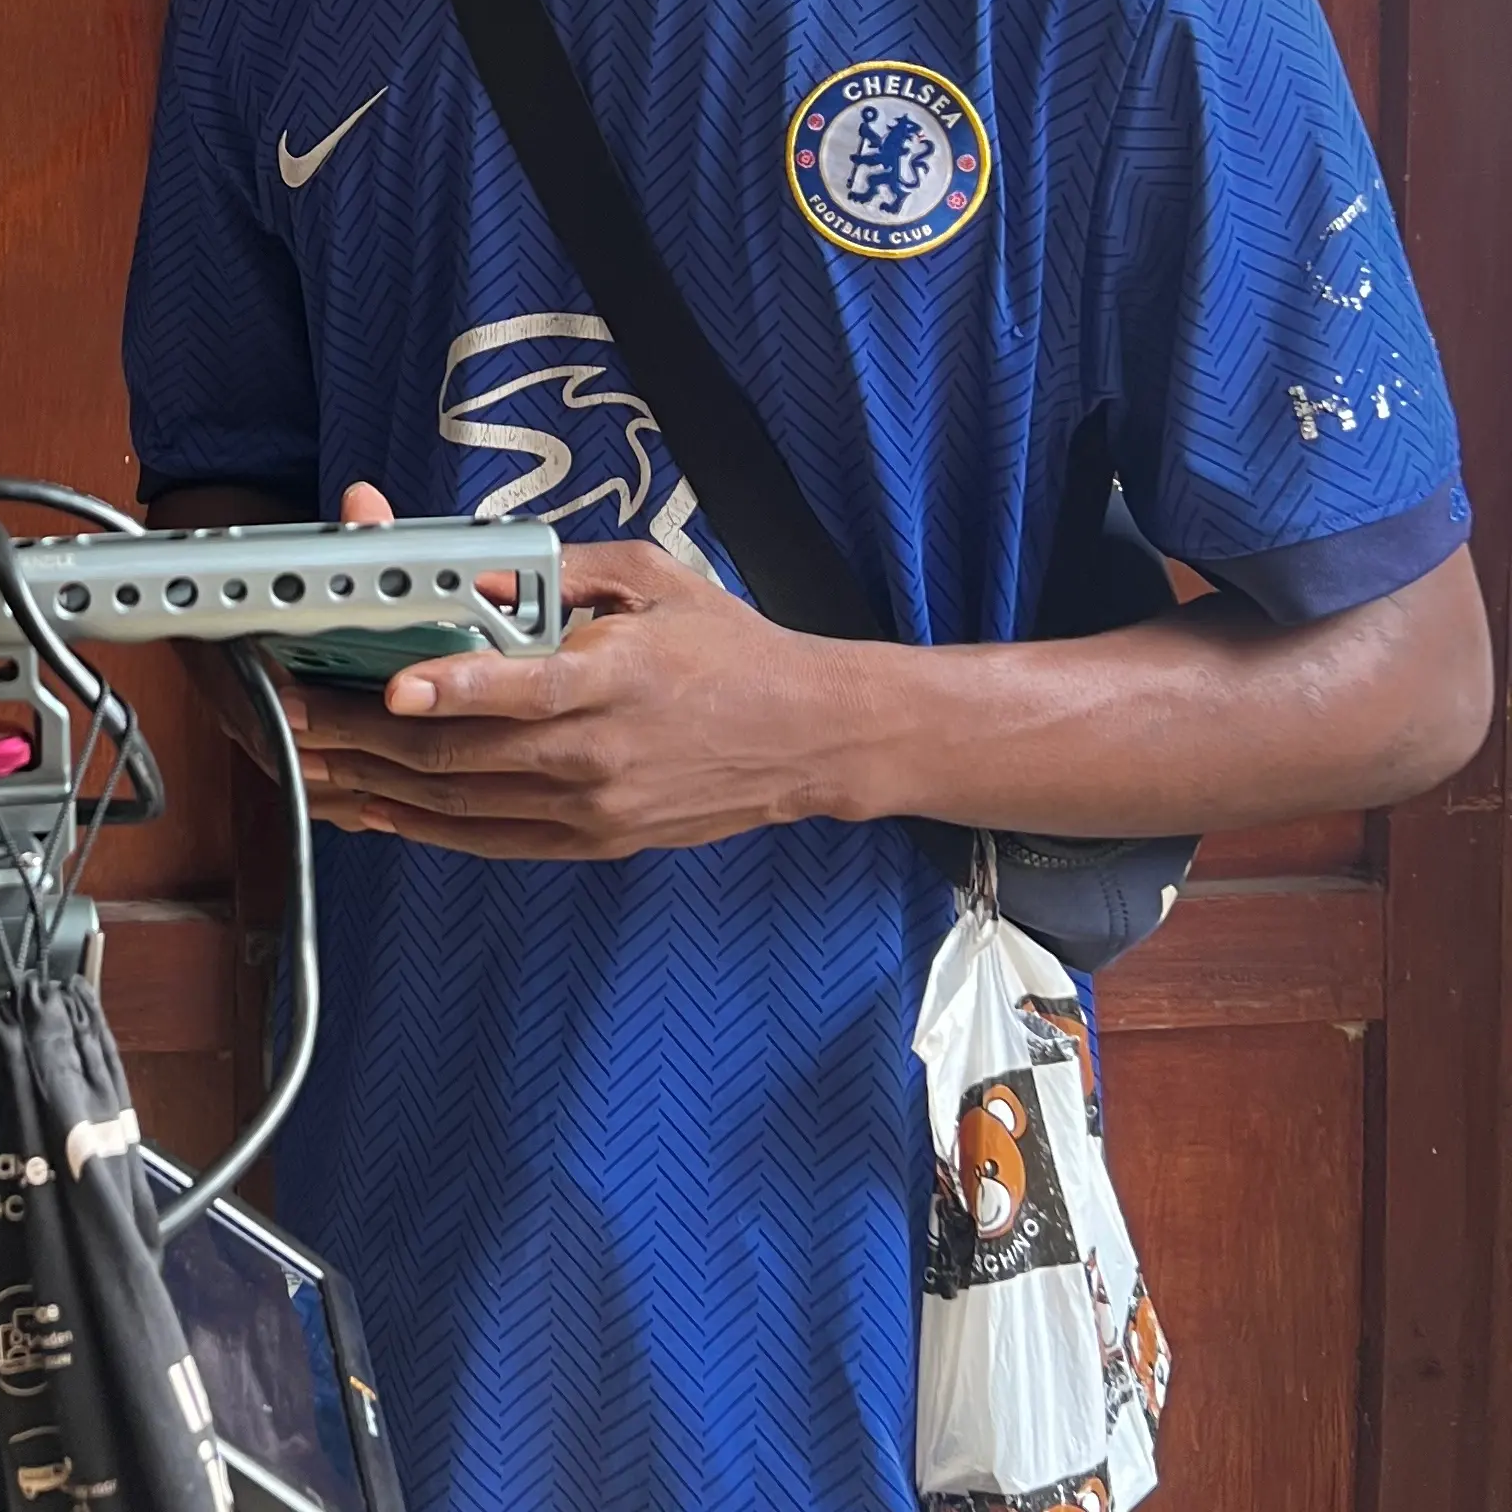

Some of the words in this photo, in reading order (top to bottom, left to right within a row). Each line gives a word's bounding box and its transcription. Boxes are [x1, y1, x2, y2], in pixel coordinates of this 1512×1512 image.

[843, 75, 962, 129] CHELSEA
[809, 194, 881, 244] FOOTBALL
[889, 224, 932, 244] CLUB
